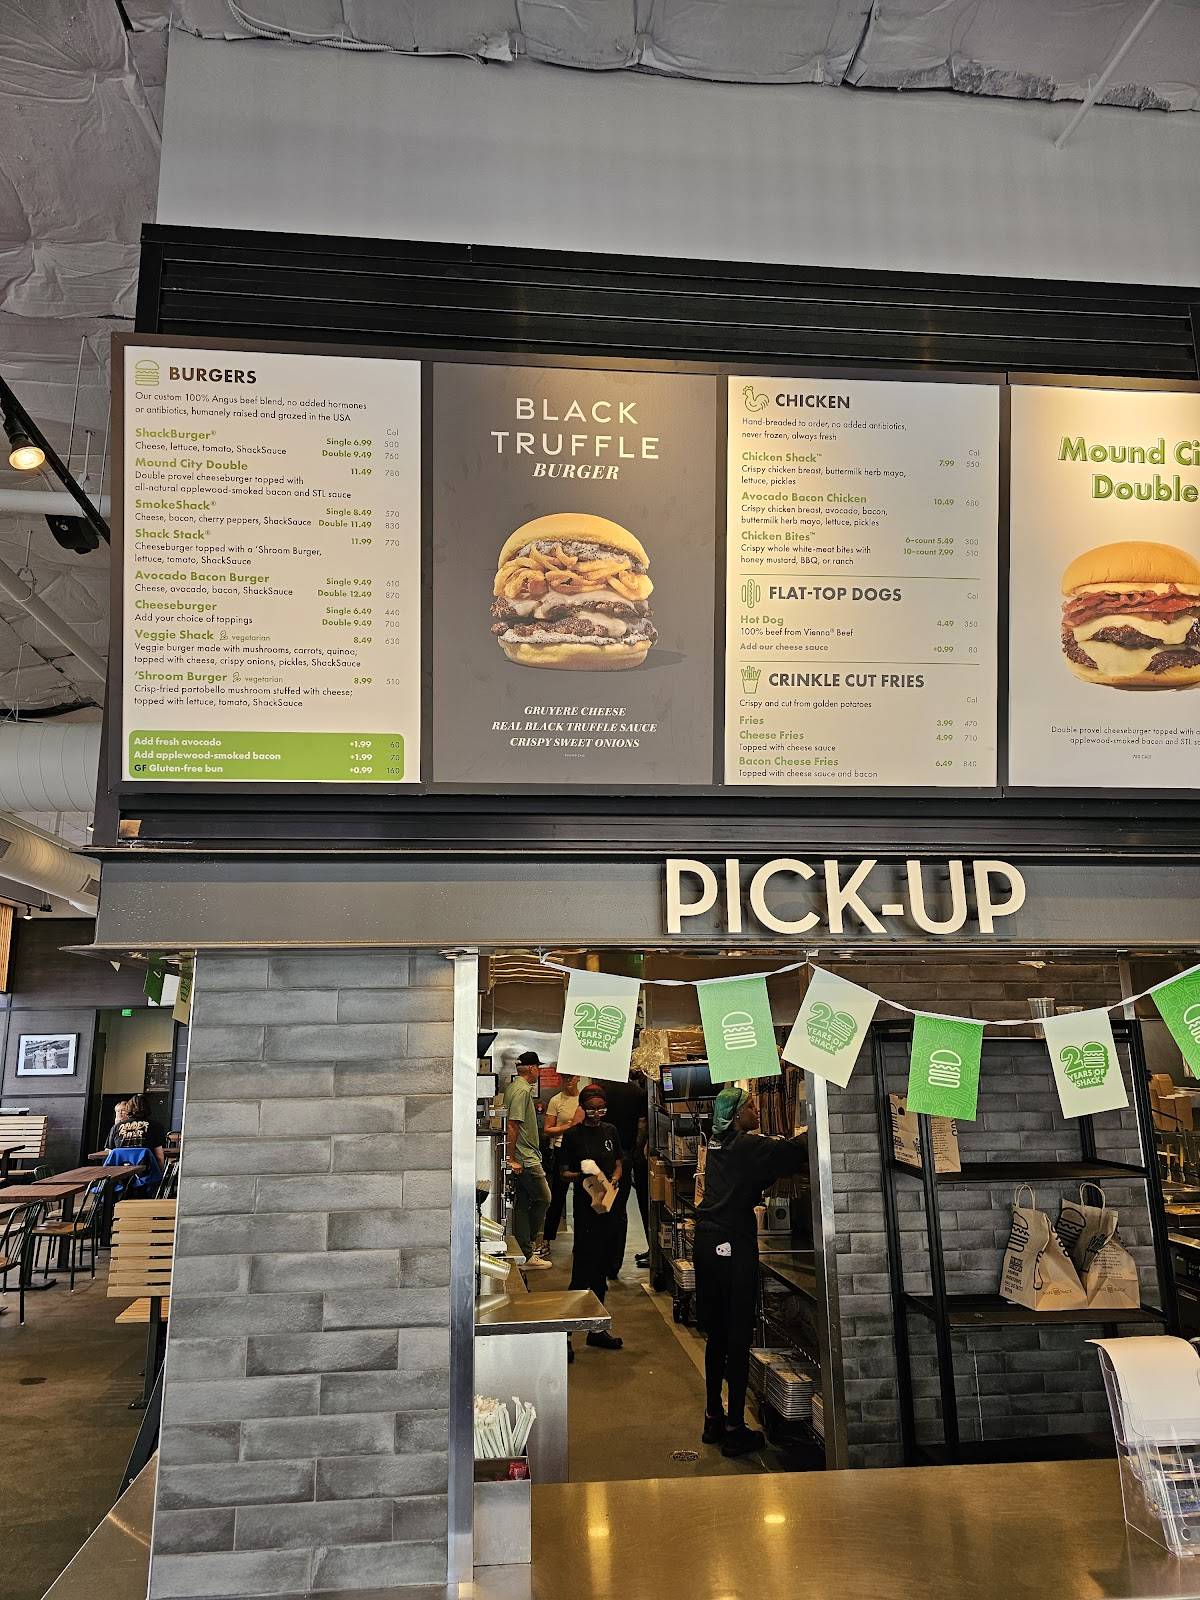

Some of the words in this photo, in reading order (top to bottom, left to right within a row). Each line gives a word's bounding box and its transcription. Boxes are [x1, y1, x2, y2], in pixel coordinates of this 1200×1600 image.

[168, 366, 257, 384] BURGERS
[776, 394, 850, 409] CHICKEN
[146, 405, 188, 415] antibiotics,
[191, 407, 230, 418] humanely
[233, 409, 257, 417] raised
[260, 410, 275, 418] and
[278, 411, 306, 420] grazed
[309, 412, 315, 420] in
[333, 413, 350, 421] USA
[517, 398, 638, 424] BLACK
[326, 438, 351, 447] Single
[491, 431, 659, 459] TRUFFLE
[742, 452, 782, 461] Chicken
[1058, 437, 1166, 465] Mound
[135, 458, 176, 467] Mound
[180, 459, 202, 471] City
[206, 459, 247, 470] Double
[742, 464, 765, 474] Crispy
[768, 465, 795, 473] chicken
[798, 466, 822, 475] breast,
[825, 466, 861, 475] buttermilk
[532, 463, 619, 480] BURGER
[134, 483, 177, 491] all-natural
[180, 485, 262, 494] applewood-smoked
[266, 487, 291, 495] bacon
[294, 488, 309, 496] and
[312, 489, 325, 497] STL
[1092, 474, 1199, 502] Double
[742, 491, 788, 501] Avocado
[792, 493, 823, 503] Bacon
[826, 493, 866, 503] Chicken
[326, 507, 350, 517] Single
[319, 519, 347, 527] Double
[135, 528, 169, 538] Shack
[741, 531, 781, 540] Chicken
[135, 570, 186, 583] Avocado
[190, 571, 225, 581] Bacon
[230, 572, 269, 585] Burger
[326, 577, 350, 586] Single
[318, 589, 346, 597] Double
[770, 586, 846, 600] FLAT-TOP
[852, 587, 901, 601] DOGS
[135, 600, 216, 612] Cheeseburger
[326, 606, 350, 615] Single
[740, 615, 759, 623] Hot
[762, 615, 783, 626] Dog
[135, 629, 175, 641] Veggie
[180, 630, 213, 639] Shack
[766, 627, 782, 635] beef
[784, 627, 801, 635] from
[837, 628, 853, 636] Beef
[134, 655, 164, 665] topped
[167, 655, 183, 663] with
[186, 656, 216, 665] cheese,
[220, 656, 244, 666] crispy
[246, 657, 275, 666] onions,
[279, 657, 308, 667] pickles,
[312, 658, 360, 667] ShackSauce
[187, 671, 226, 683] Burger
[769, 673, 839, 686] CRINKLE
[845, 674, 876, 687] CUT
[882, 674, 924, 687] FRIES
[134, 684, 178, 694] Crisp-fried
[182, 685, 225, 695] portobello
[228, 686, 270, 694] mushroom
[273, 686, 300, 694] stuffed
[303, 687, 319, 695] with
[322, 687, 352, 697] cheese;
[525, 706, 578, 716] GRUYERE
[581, 707, 626, 716] CHEESE
[739, 715, 763, 724] Fries
[492, 722, 522, 731] REAL
[525, 722, 563, 731] BLACK
[567, 723, 617, 732] TRUFFLE
[620, 723, 657, 732] SAUCE
[1051, 726, 1076, 734] Double
[1079, 726, 1101, 734] provel
[1104, 726, 1150, 735] cheeseburger
[1153, 727, 1177, 736] topped
[739, 730, 776, 739] Cheese
[780, 730, 803, 739] Fries
[134, 737, 153, 745] Add
[155, 737, 179, 745] fresh
[181, 738, 221, 746] avocado
[510, 738, 551, 747] CRISPY
[554, 738, 592, 747] SWEET
[595, 739, 639, 747] ONIONS
[134, 750, 153, 758] Add
[156, 751, 250, 760] applewood-smoked
[252, 751, 280, 760] bacon
[739, 756, 770, 765] Bacon
[774, 756, 811, 765] Cheese
[814, 756, 838, 766] Fries
[134, 764, 147, 772] GF
[149, 764, 202, 772] Gluten-free
[205, 764, 223, 772] bun
[665, 858, 1026, 934] PICK-UP
[576, 1030, 602, 1039] YEARS
[605, 1034, 616, 1042] OF
[807, 1026, 832, 1040] YEARS
[833, 1038, 844, 1047] OF
[581, 1038, 608, 1048] SHACK
[810, 1035, 836, 1051] SHACK
[1069, 1070, 1092, 1081] YEARS
[1095, 1069, 1104, 1077] OF
[1076, 1077, 1101, 1087] SHACK
